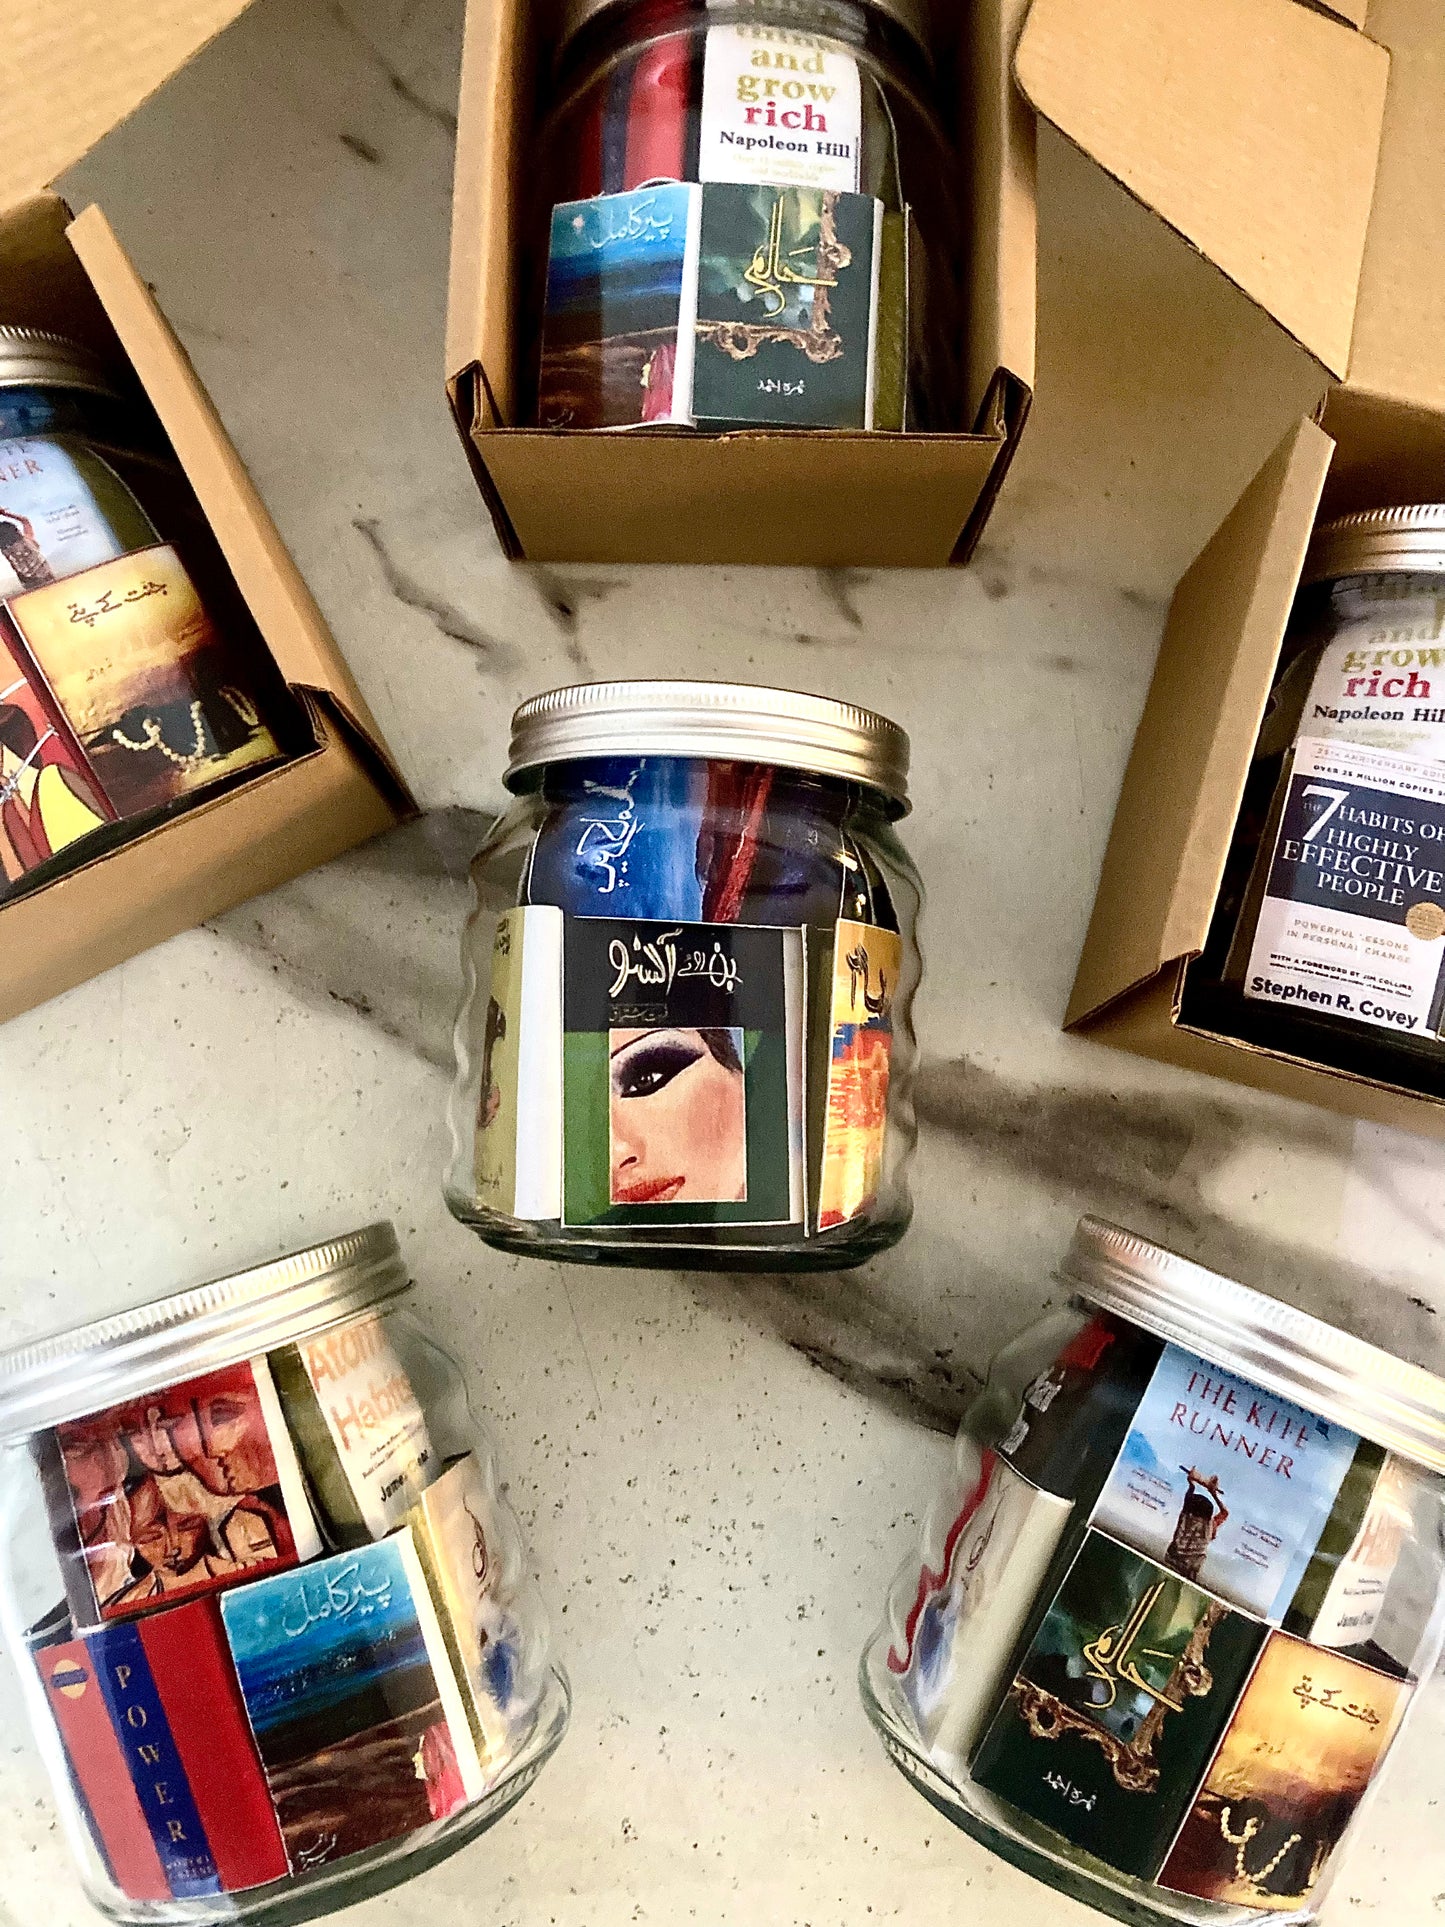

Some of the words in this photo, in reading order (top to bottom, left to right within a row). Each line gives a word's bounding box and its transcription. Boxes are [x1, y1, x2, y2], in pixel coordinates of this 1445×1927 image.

[751, 49, 825, 75] and
[736, 74, 837, 103] grow
[744, 101, 828, 133] rich
[720, 131, 809, 154] Napoleon
[816, 141, 851, 159] Hill
[1341, 648, 1445, 674] grow
[1342, 669, 1432, 699] rich
[1312, 704, 1405, 723] Napoleon
[1411, 707, 1445, 724] Hil
[1313, 764, 1339, 774] OVER
[1342, 769, 1353, 777] 25
[1356, 772, 1396, 787] MILLION
[1399, 781, 1435, 795] COPIES
[1300, 783, 1350, 842] 7
[1338, 805, 1415, 835] HABITS
[1326, 827, 1420, 862] HIGHLY
[1281, 839, 1445, 894] EFFECTIVE
[1317, 871, 1406, 907] PEOPLE
[1286, 929, 1300, 938] IN
[1294, 918, 1355, 940] POWERFUL
[1270, 953, 1292, 963] WITH
[1294, 957, 1300, 965] A
[1302, 960, 1348, 975] FOREWORD
[1350, 970, 1361, 978] BY
[1250, 976, 1332, 1006] Stephen
[1336, 993, 1355, 1012] R.
[1359, 1000, 1419, 1030] Covey
[1186, 1370, 1238, 1416] THE
[1245, 1400, 1310, 1449] KITE
[1169, 1401, 1295, 1480] RUNNER
[114, 1664, 189, 1843] POWER
